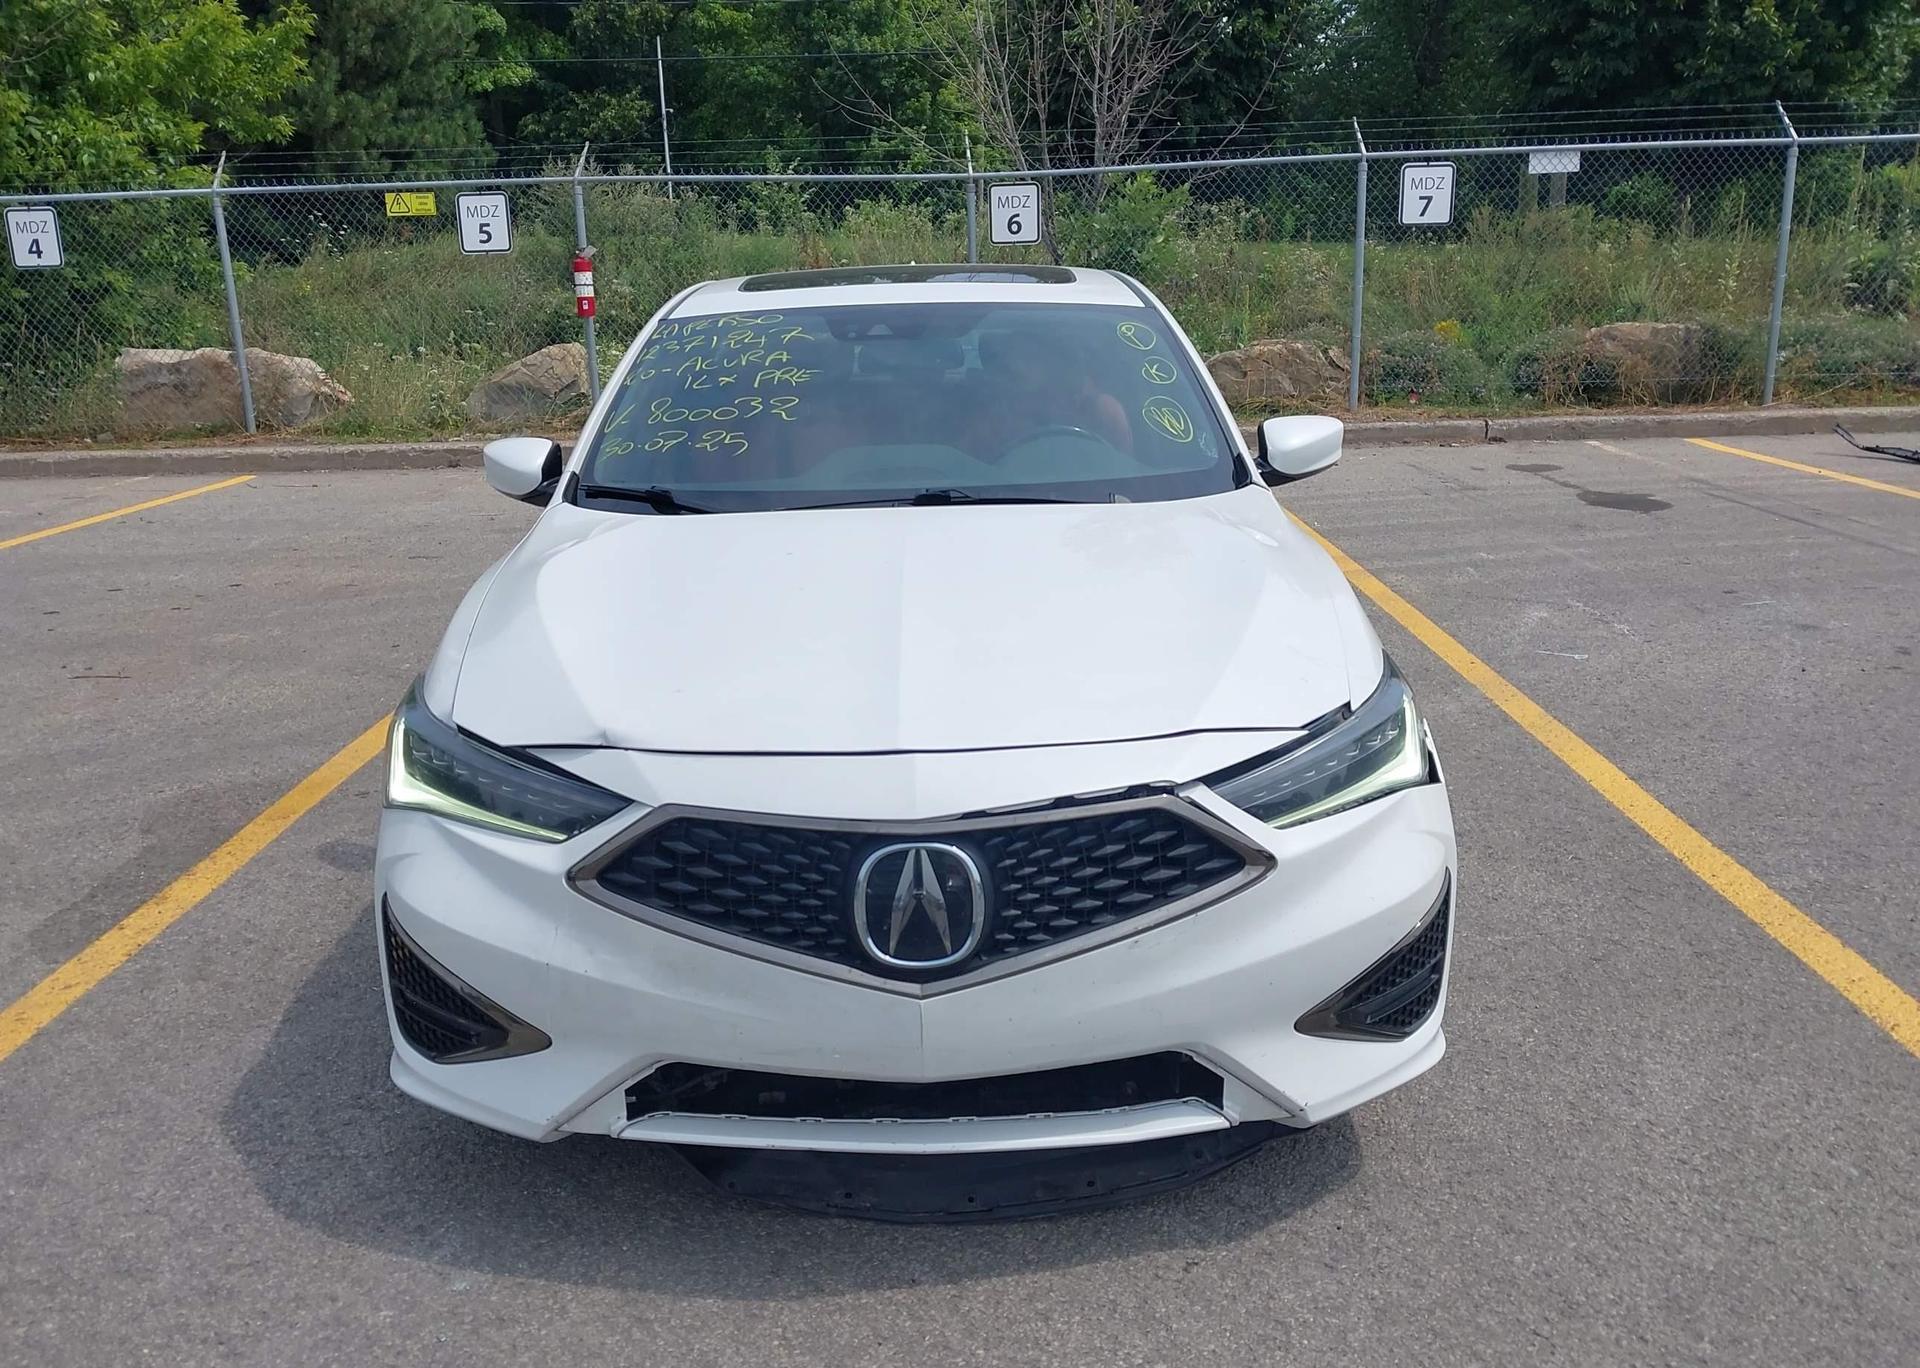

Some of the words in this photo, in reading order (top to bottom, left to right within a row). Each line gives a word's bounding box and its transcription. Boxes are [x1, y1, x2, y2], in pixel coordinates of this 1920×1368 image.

[1411, 176, 1446, 191] MDZ
[997, 194, 1031, 209] MDZ
[1418, 195, 1434, 217] 7
[466, 205, 500, 219] MDZ
[15, 220, 49, 234] MDZ
[478, 222, 493, 244] 5
[1007, 213, 1022, 235] 6
[28, 238, 43, 259] 4
[1144, 362, 1169, 382] K
[648, 397, 799, 424] 800032
